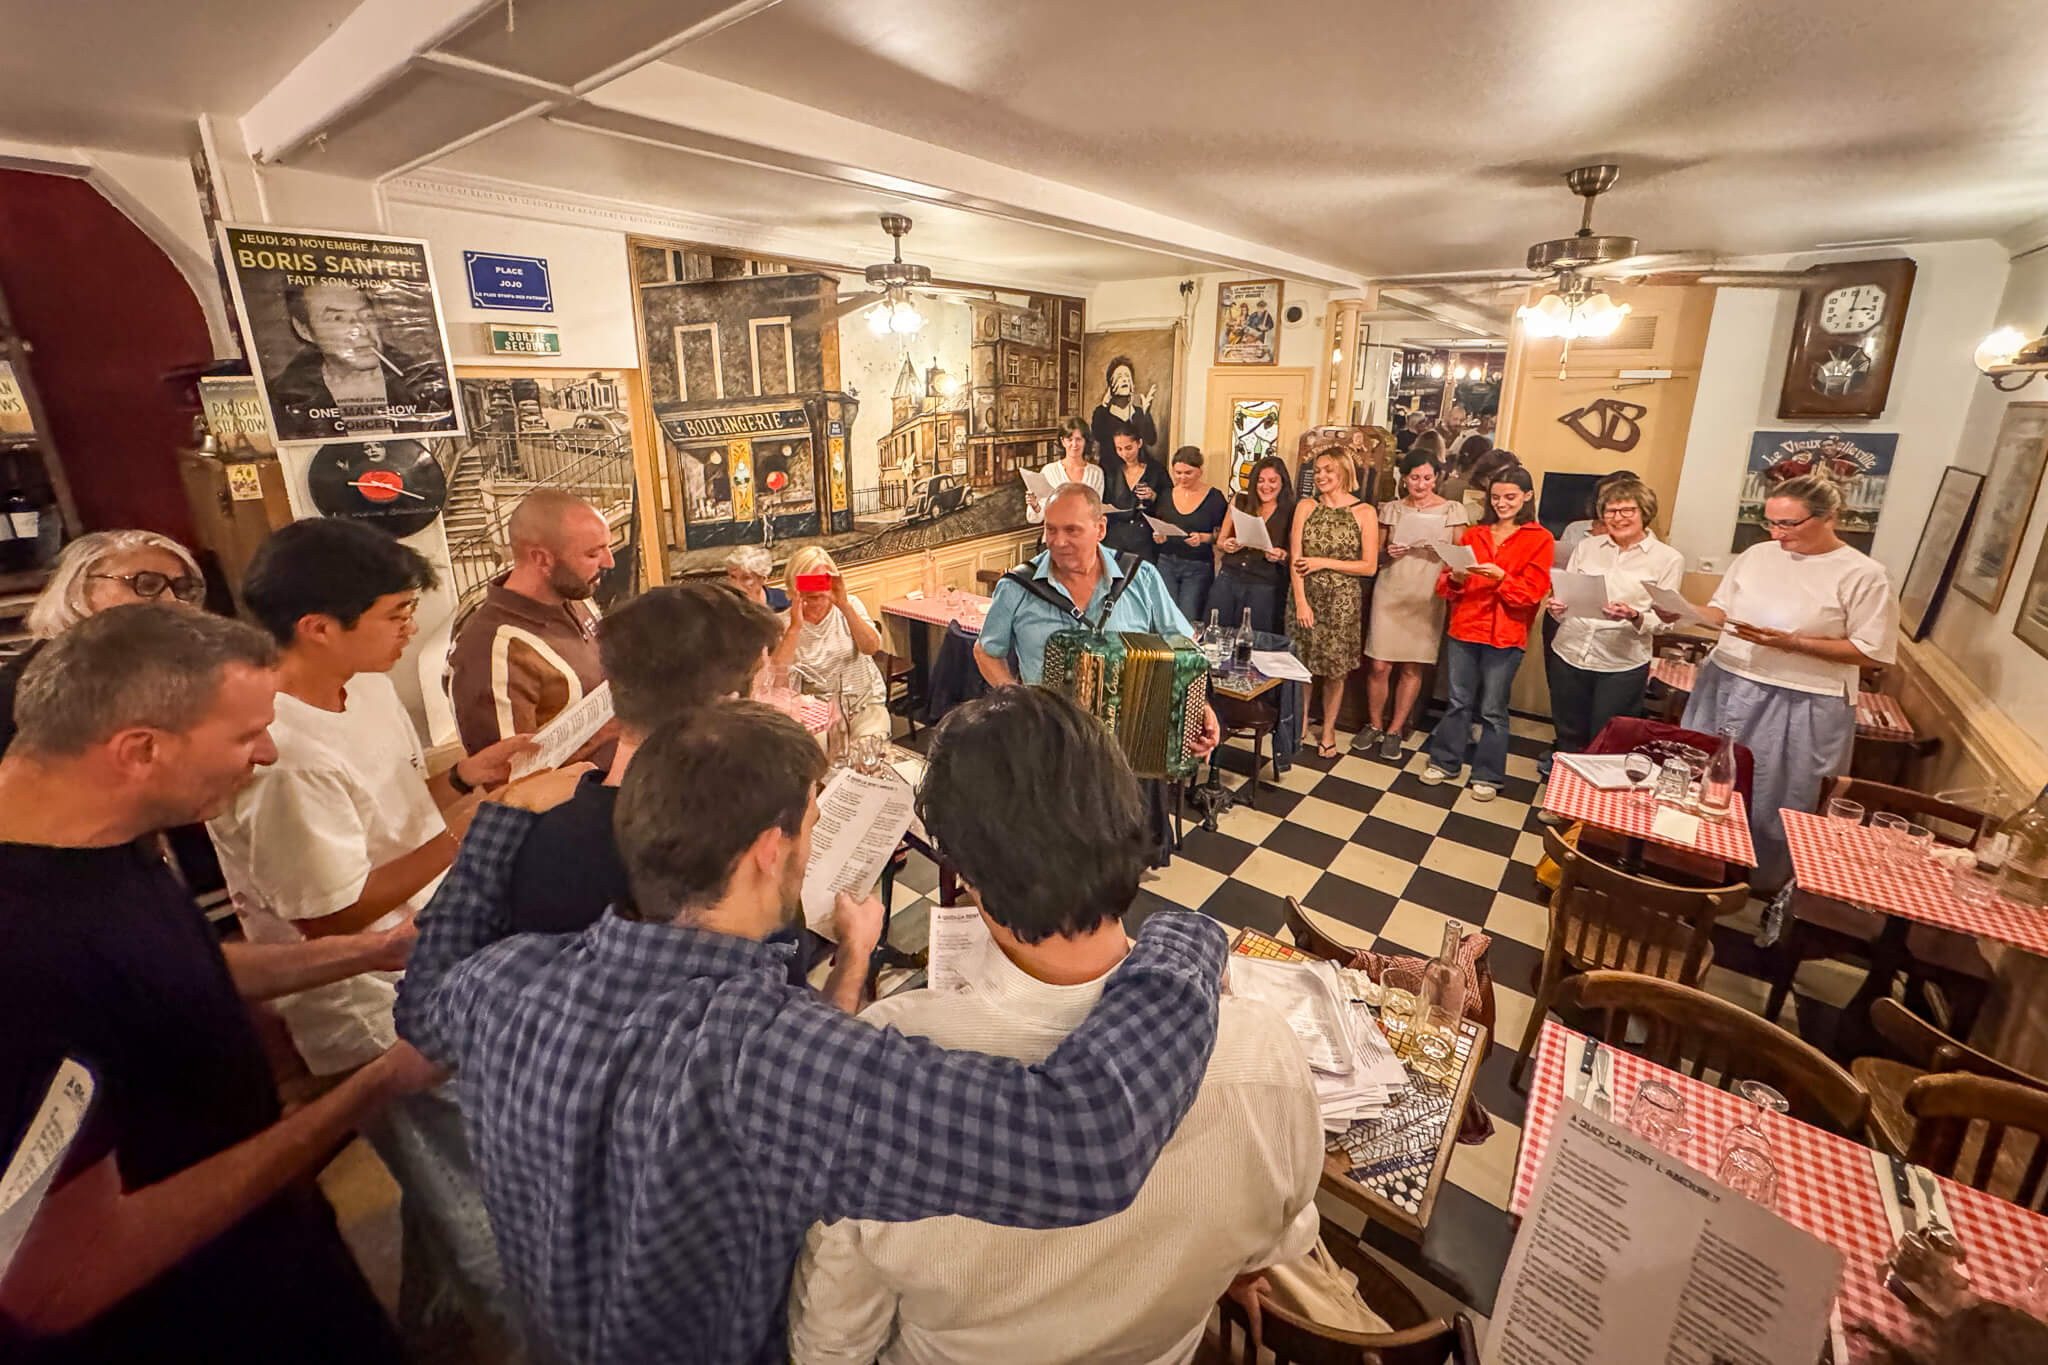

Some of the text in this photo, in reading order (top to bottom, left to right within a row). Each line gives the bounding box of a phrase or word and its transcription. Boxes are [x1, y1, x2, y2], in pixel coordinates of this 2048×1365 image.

[239, 233, 279, 246] JEUDI
[282, 236, 297, 247] 29
[299, 238, 369, 253] NOVEMBRE
[238, 249, 423, 278] BORIS SANTEFF
[495, 266, 523, 276] PLACE
[286, 274, 315, 287] FAIT
[320, 276, 348, 288] SON
[508, 331, 546, 342] SORTIE
[505, 342, 552, 352] SECOURS
[308, 407, 340, 419] ONE
[334, 418, 399, 431] CONCERT
[683, 412, 784, 437] BOULANGERIE
